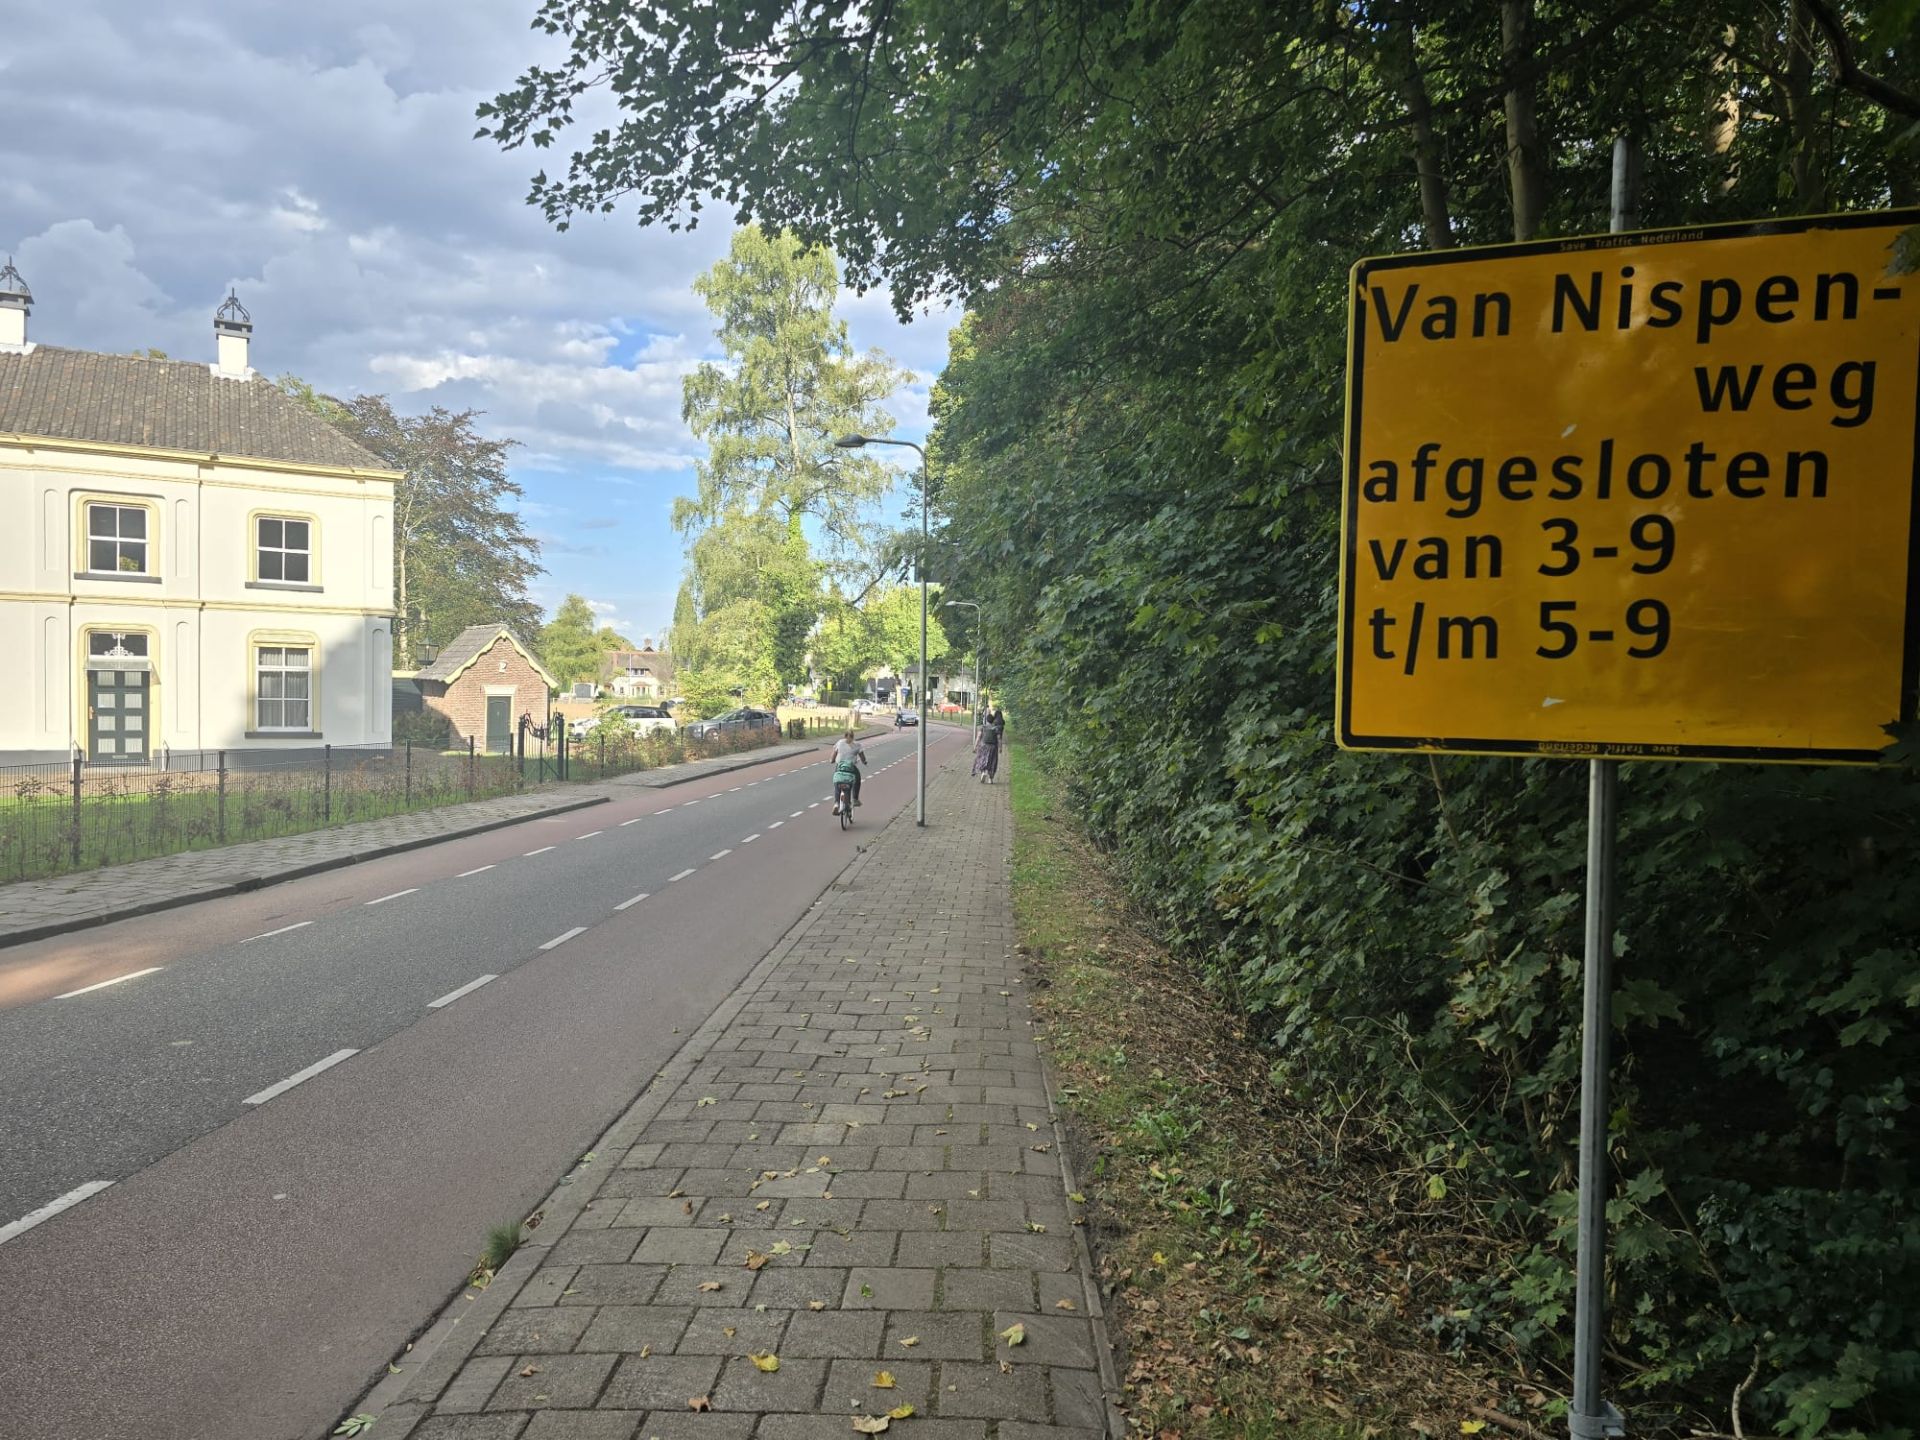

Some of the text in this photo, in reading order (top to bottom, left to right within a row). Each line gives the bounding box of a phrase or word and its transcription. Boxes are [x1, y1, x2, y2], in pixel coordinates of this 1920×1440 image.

[1559, 230, 1704, 252] Save Traffic Nederland
[1370, 265, 1903, 345] Van Nispen-
[1693, 360, 1878, 429] weg
[1362, 438, 1830, 519] afgesloten
[1368, 513, 1676, 581] van 3-9
[1368, 598, 1671, 676] t/m 5-9
[1605, 743, 1644, 755] Traffic
[1653, 745, 1680, 756] Save
